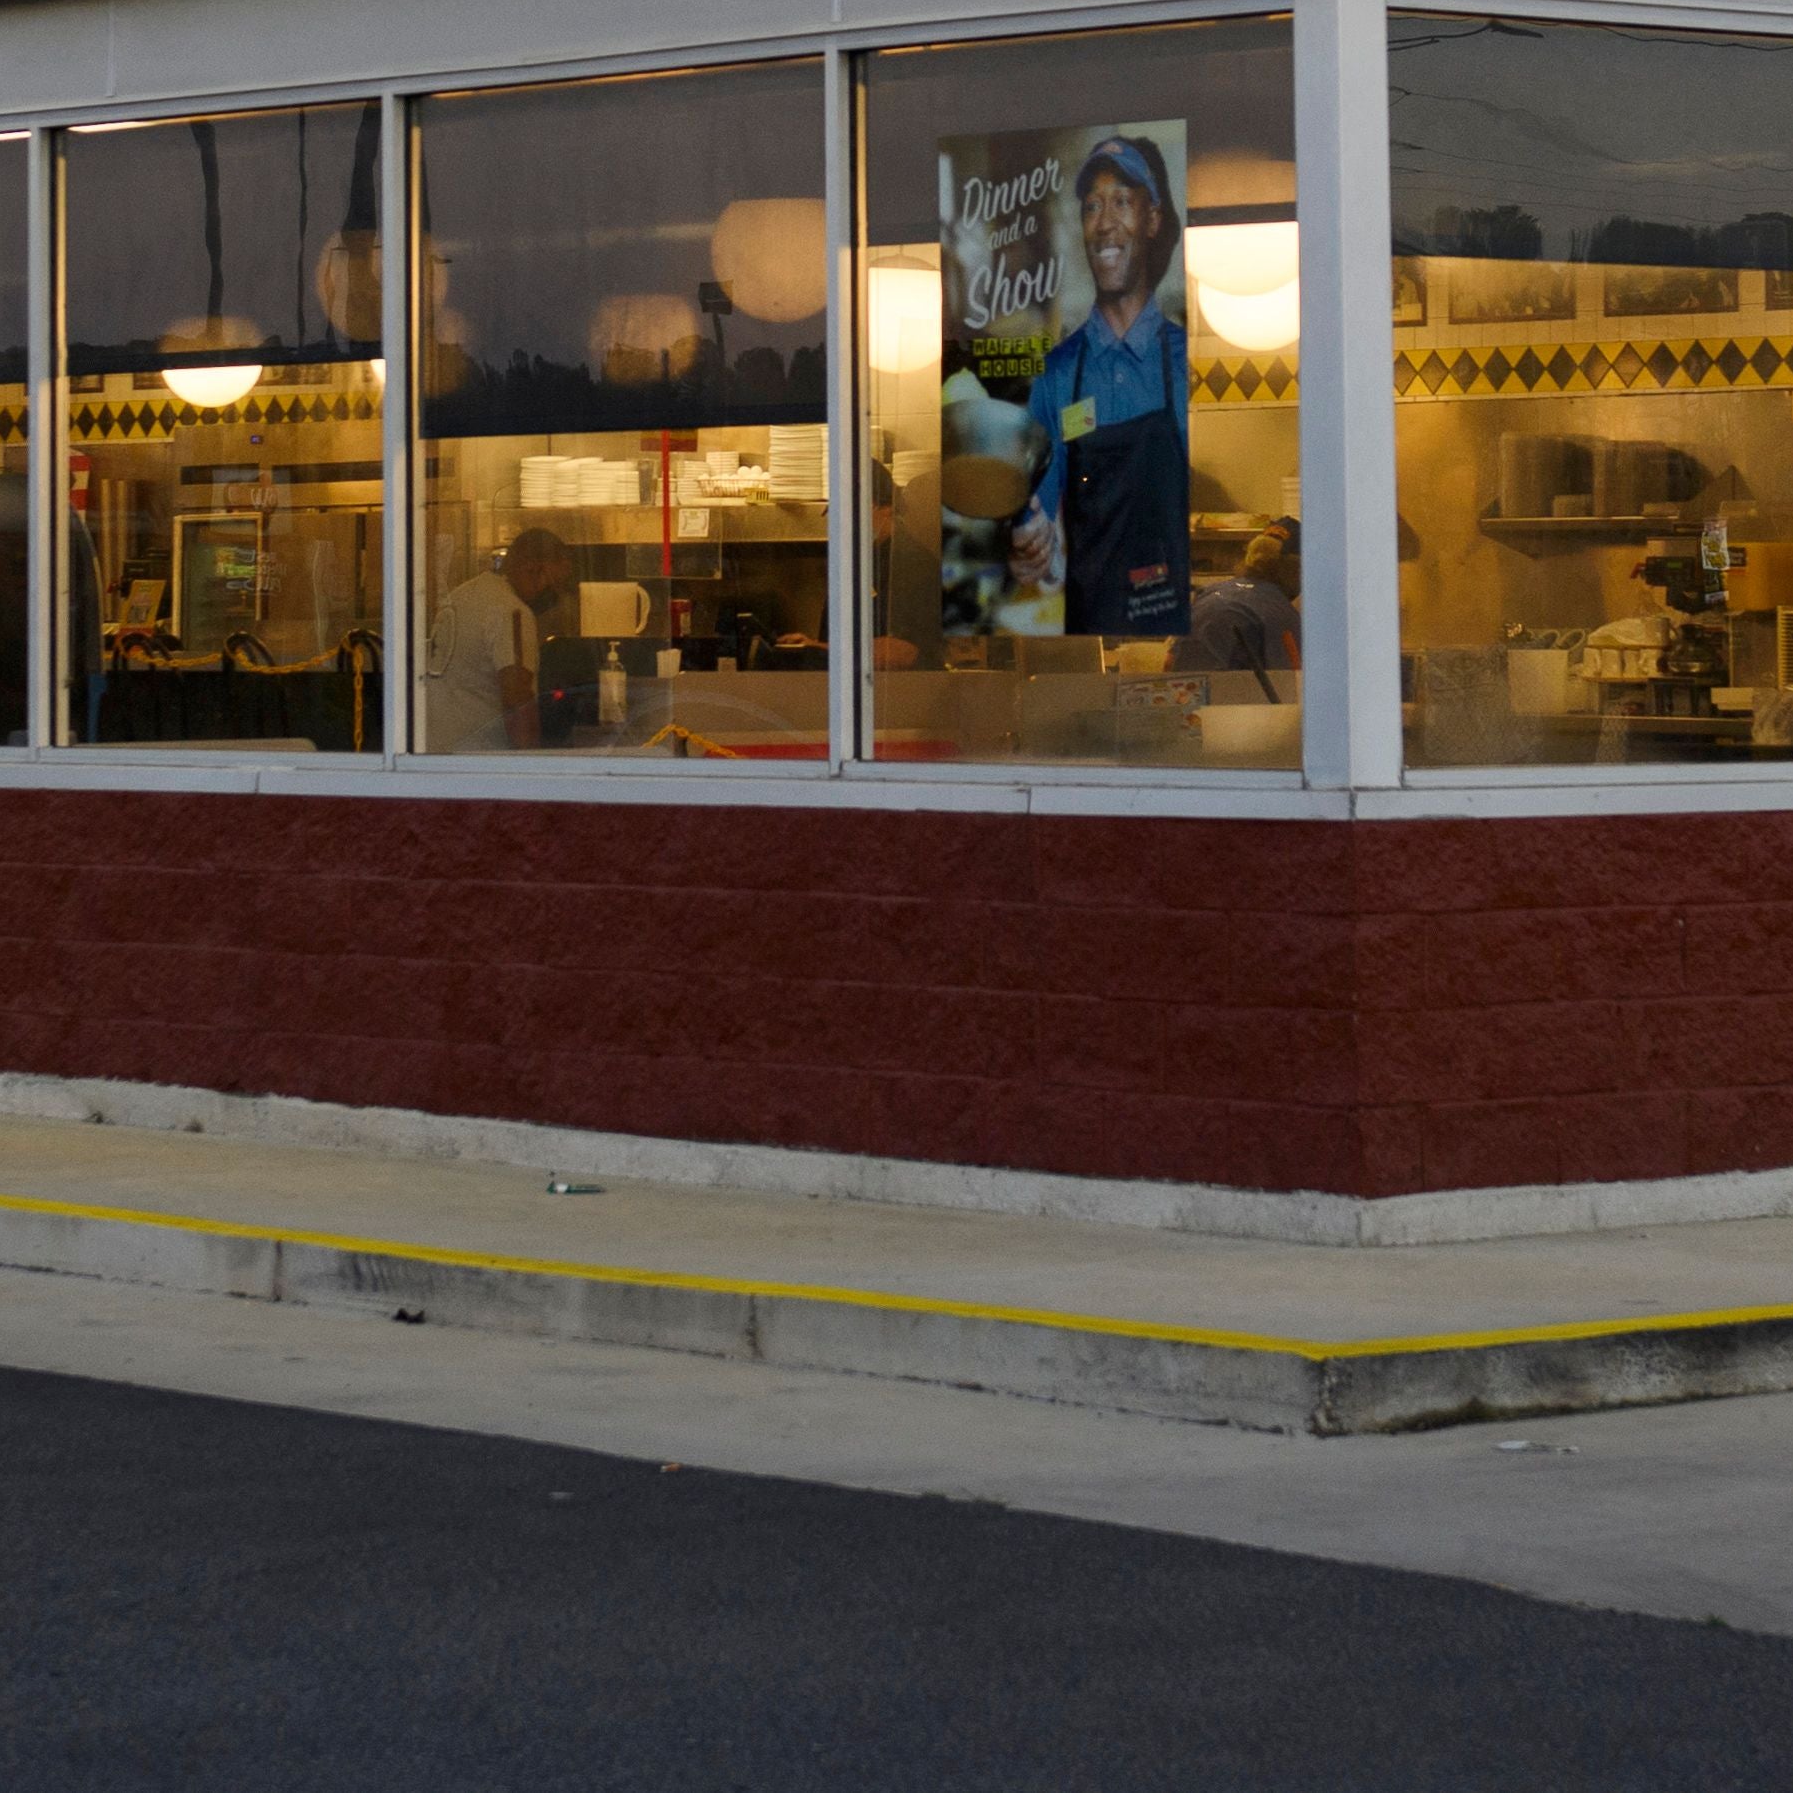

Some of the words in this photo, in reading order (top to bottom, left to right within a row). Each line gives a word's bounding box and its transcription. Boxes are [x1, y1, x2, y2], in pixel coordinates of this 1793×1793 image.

[962, 157, 1065, 230] Dinner
[990, 212, 1023, 250] and
[1024, 214, 1039, 237] a
[964, 253, 1065, 330] Show
[973, 336, 1052, 356] WAFFLE
[979, 358, 1046, 378] HOUSE
